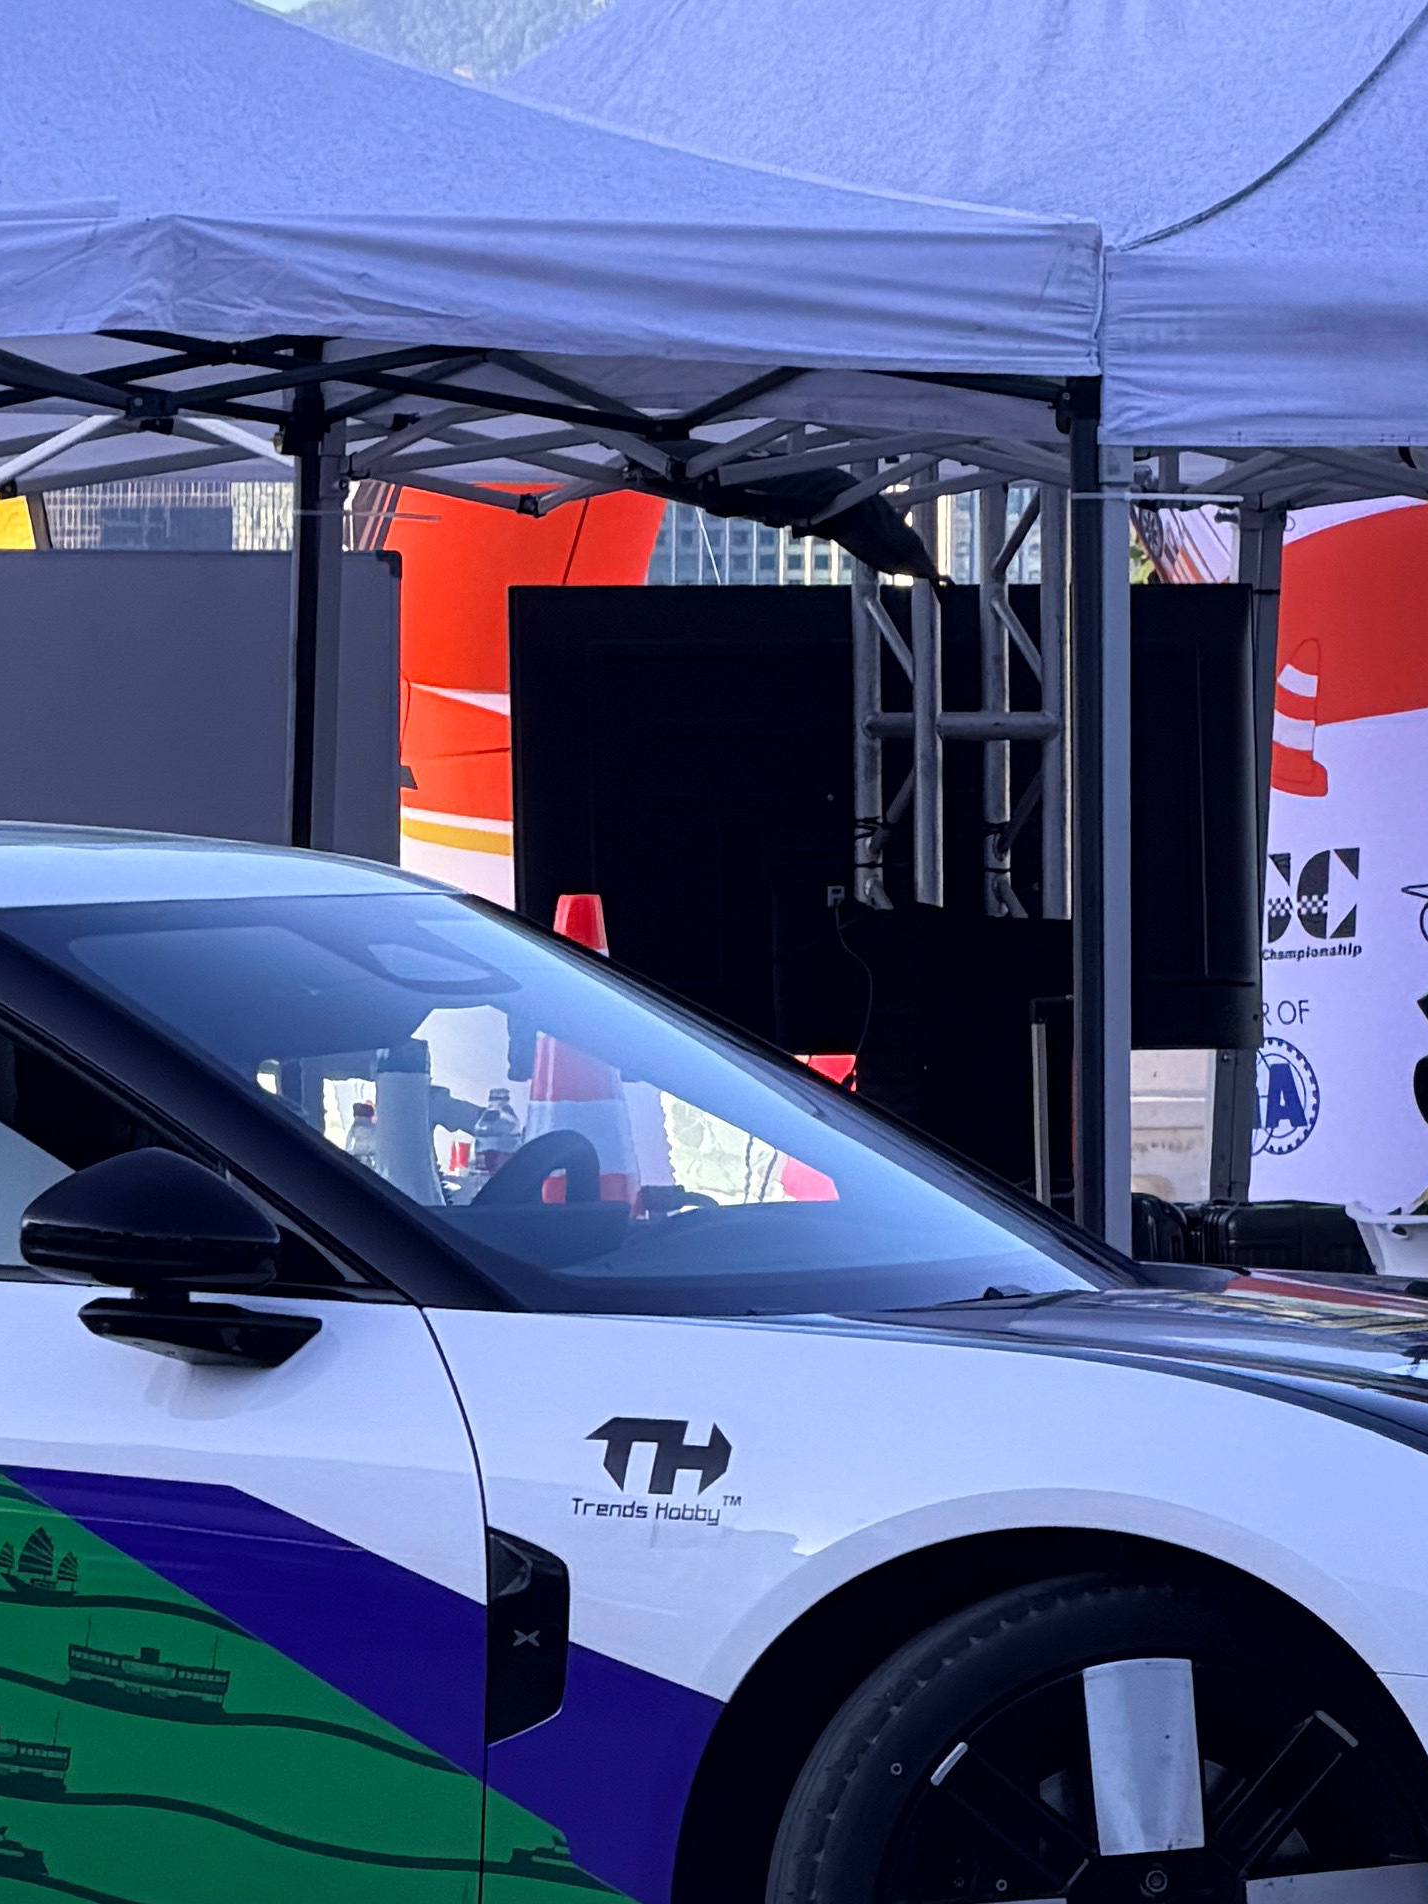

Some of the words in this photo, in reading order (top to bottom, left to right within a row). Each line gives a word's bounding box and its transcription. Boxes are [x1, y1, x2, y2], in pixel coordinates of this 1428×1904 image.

[1277, 999, 1310, 1025] OF
[584, 1416, 732, 1495] TH
[572, 1498, 648, 1519] Trends
[655, 1502, 721, 1526] Hobby
